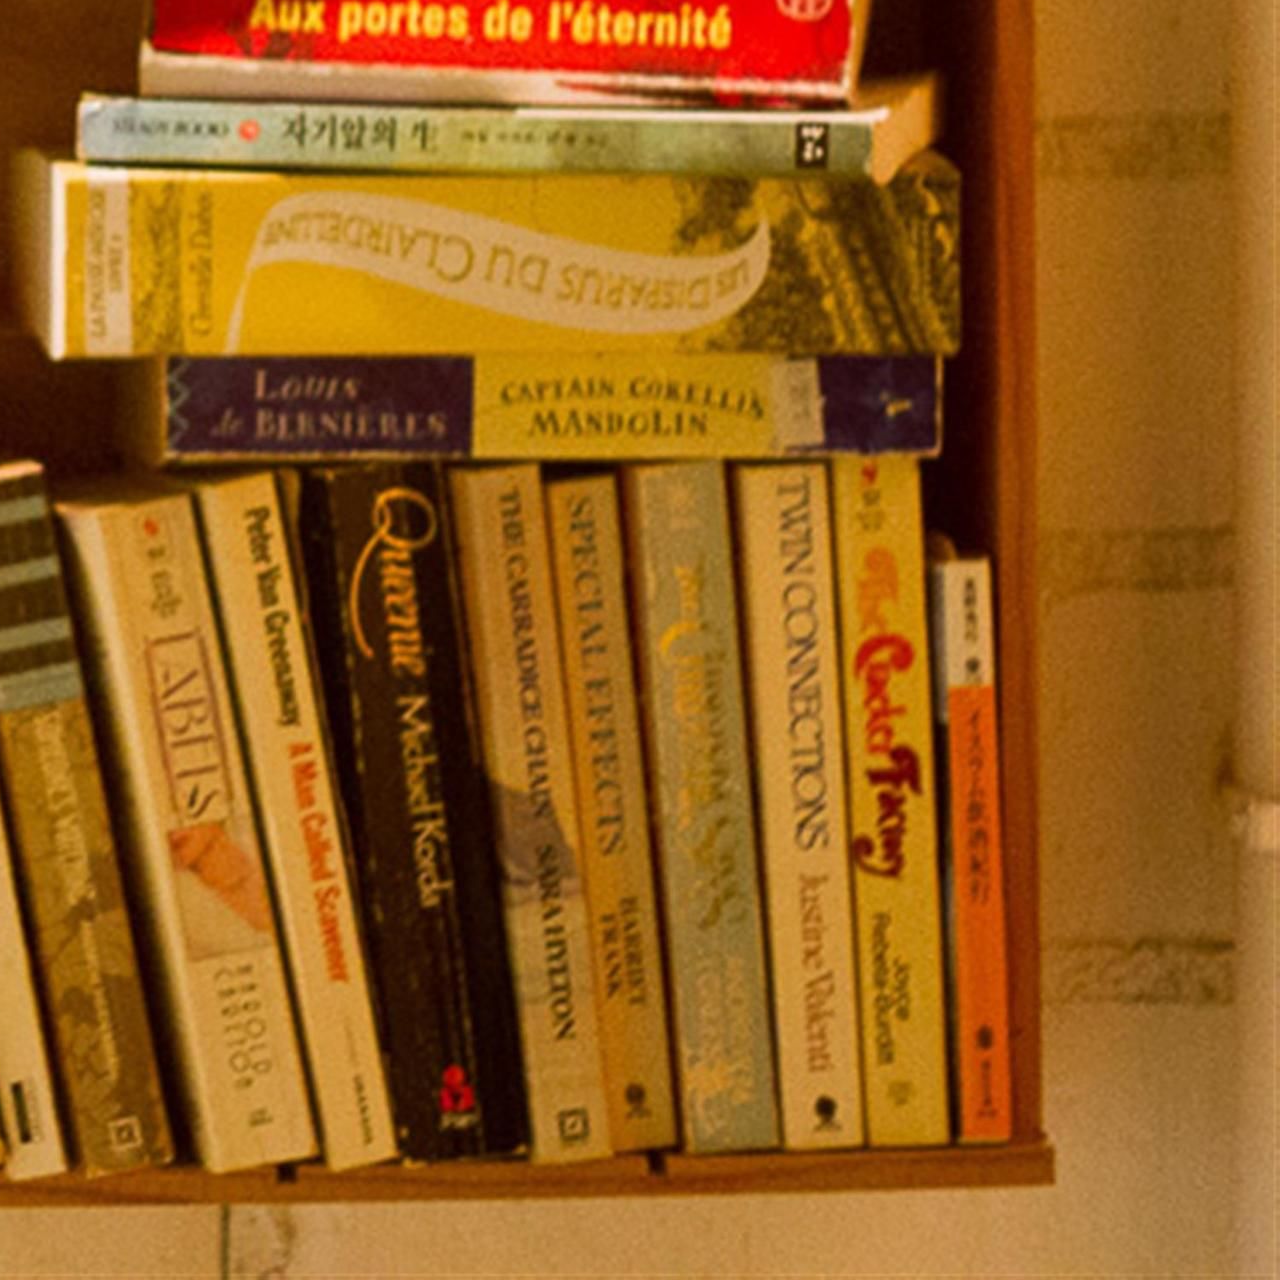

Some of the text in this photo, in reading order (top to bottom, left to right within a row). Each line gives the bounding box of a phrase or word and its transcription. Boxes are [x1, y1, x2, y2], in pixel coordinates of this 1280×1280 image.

[483, 0, 532, 42] de
[259, 210, 476, 283] CLAIRDELUNE
[485, 246, 551, 294] DU
[554, 265, 712, 312] DISPARUS
[500, 380, 617, 407] CAPTAIN
[527, 409, 708, 439] MANDOLIN
[243, 505, 277, 564] Peter
[500, 488, 529, 549] THE
[253, 566, 286, 610] Van
[506, 556, 546, 720] CARRADICE
[350, 487, 455, 908] Queenie Michael Korda
[567, 495, 627, 857] SPECIAL EFFECTS
[288, 741, 314, 762] A
[524, 725, 556, 818] CHAIN
[778, 475, 837, 1072] TWIN CONNECTIONS Justine Valenti
[292, 767, 322, 808] Man
[296, 812, 337, 881] Called
